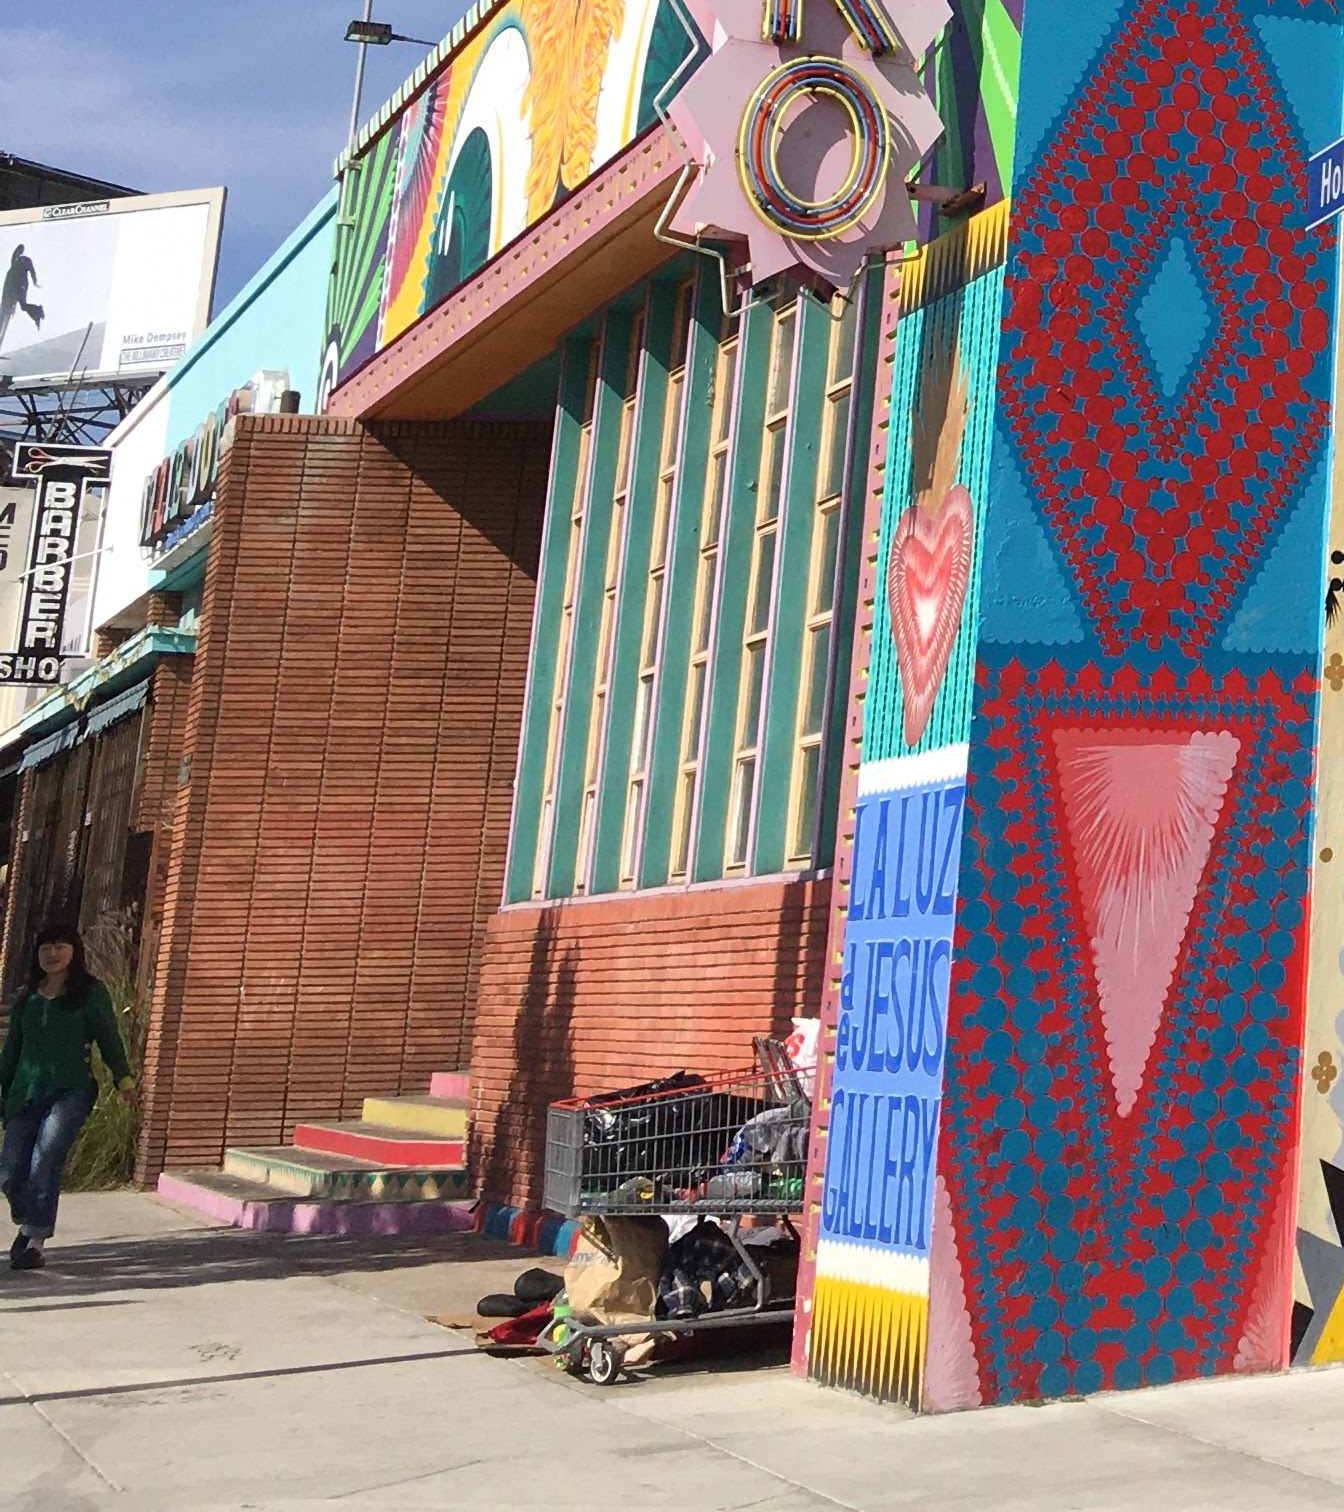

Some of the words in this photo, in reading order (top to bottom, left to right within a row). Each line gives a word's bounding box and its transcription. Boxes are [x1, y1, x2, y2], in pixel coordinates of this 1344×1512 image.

[122, 333, 144, 345] Mike
[147, 331, 187, 343] Dempsey
[24, 481, 77, 649] BARBER
[0, 655, 64, 681] SHO
[848, 803, 887, 921] LA
[890, 785, 965, 918] LUZ
[851, 935, 952, 1077] JESUS
[822, 1088, 942, 1250] GALLERY
